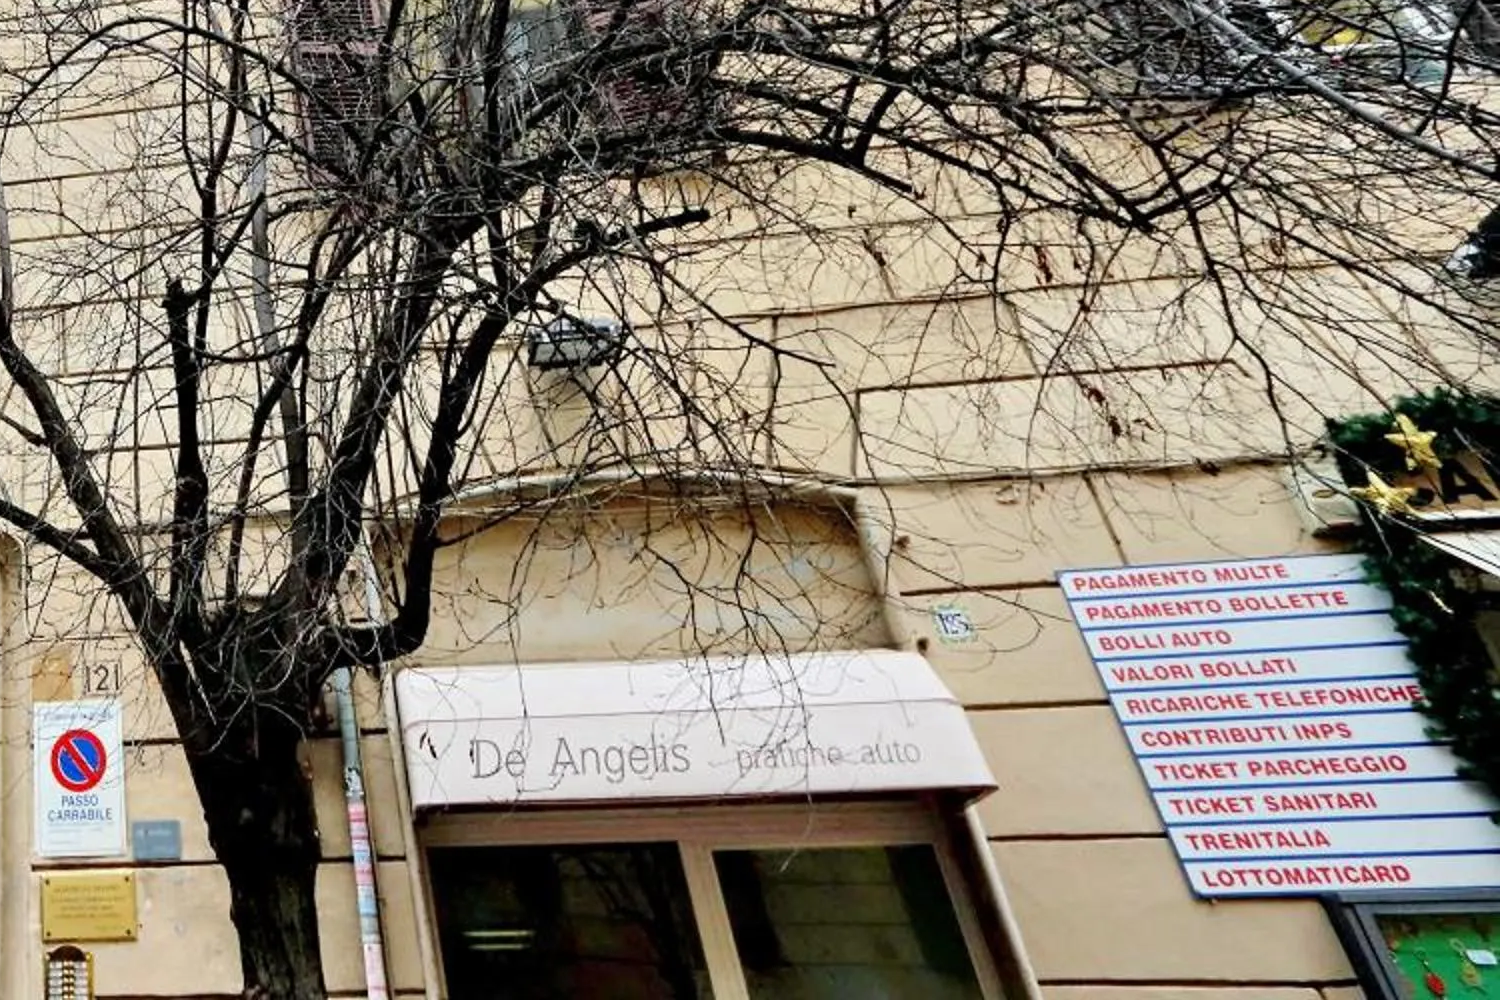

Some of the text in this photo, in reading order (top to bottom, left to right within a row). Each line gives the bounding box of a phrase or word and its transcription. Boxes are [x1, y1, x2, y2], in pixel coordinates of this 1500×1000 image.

[1073, 563, 1291, 592] PAGAMENTO MULTE
[1085, 590, 1349, 621] PAGAMENTO BOLLETTE
[1097, 629, 1233, 653] BOLLI AUTO
[1111, 658, 1297, 684] VALORI BOLLATI
[1125, 684, 1426, 716] RICARICHE TELEFONICHE
[1140, 722, 1353, 748] CONTRIBUTI INPS
[470, 739, 526, 779] De
[550, 736, 692, 783] Angelis
[860, 739, 921, 764] auto
[1154, 755, 1409, 781] TICKET PARCHEGGIO
[60, 795, 100, 807] PASSO
[1169, 791, 1378, 816] TICKET SANITARI
[47, 808, 113, 822] CARRABILE
[1184, 829, 1332, 851] TRENITALIA
[1201, 864, 1412, 890] LOTTOMATICARD
